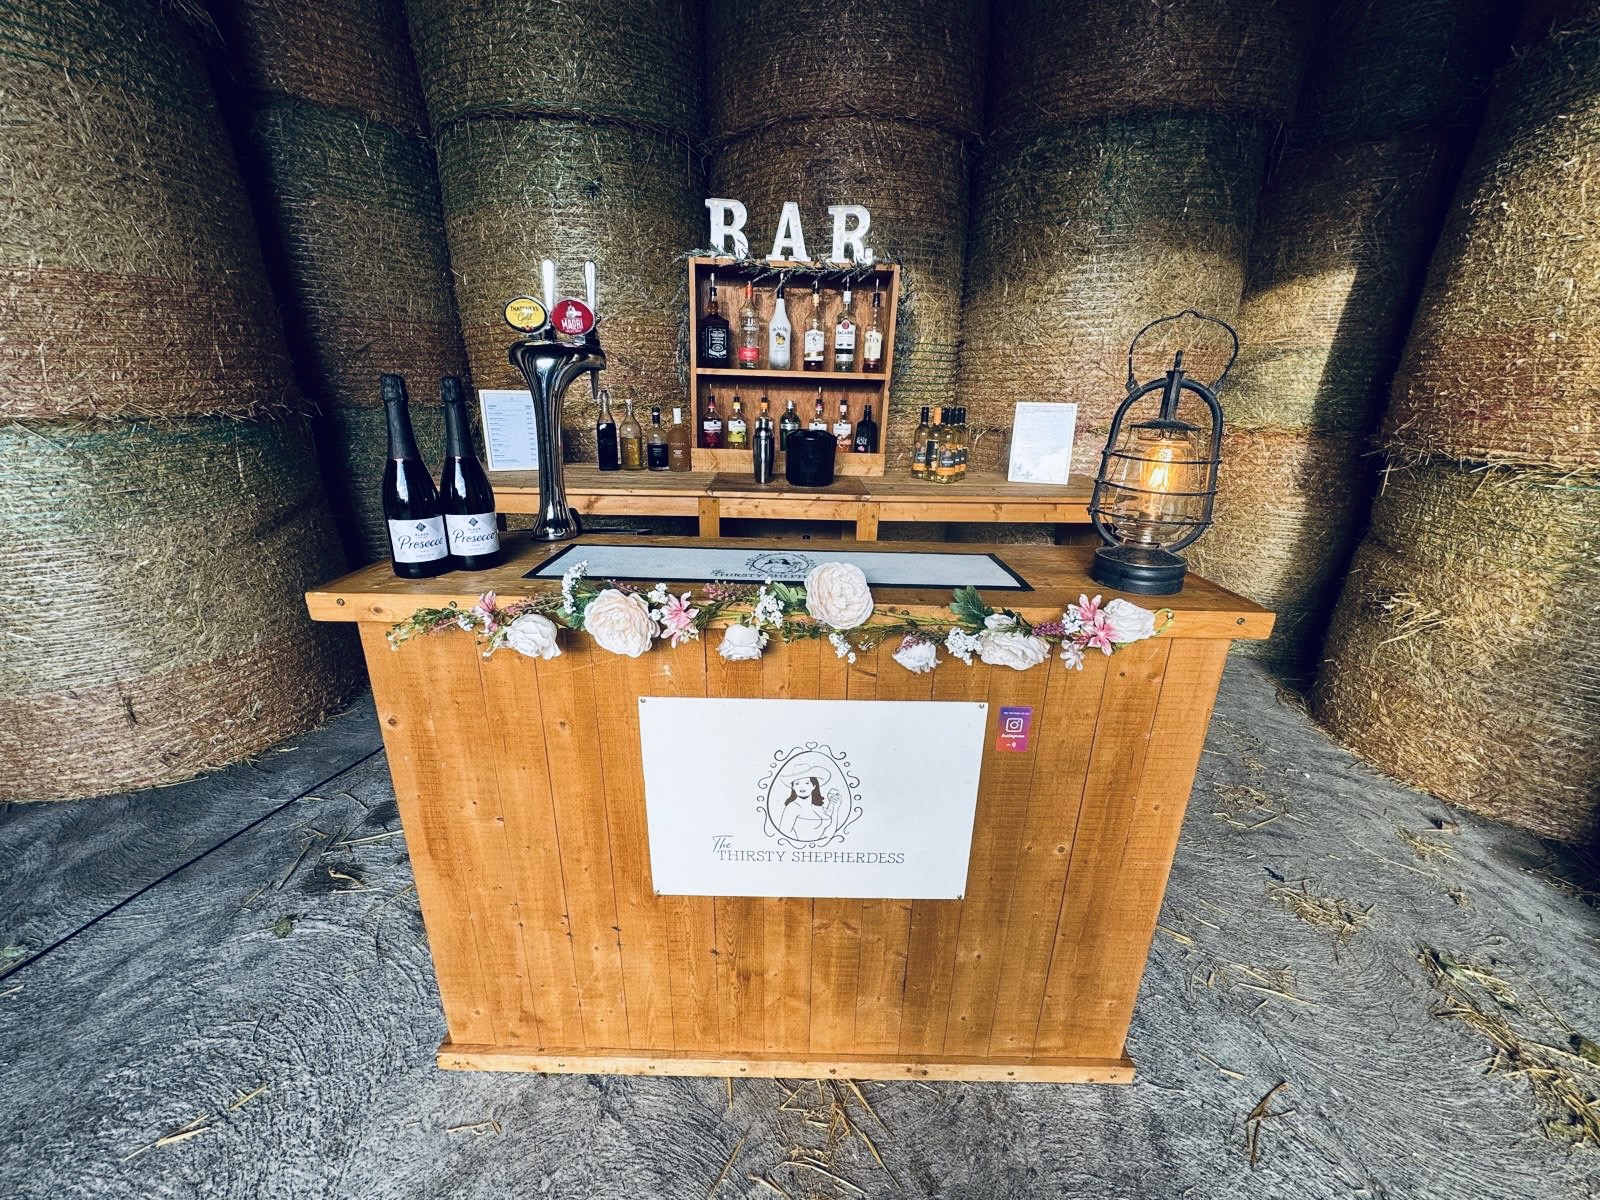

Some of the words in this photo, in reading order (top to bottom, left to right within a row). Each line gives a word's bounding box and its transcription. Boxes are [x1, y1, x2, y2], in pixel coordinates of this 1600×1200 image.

[704, 197, 874, 266] BAR
[398, 535, 443, 550] Prosecco
[453, 529, 496, 543] Prosecco
[712, 835, 733, 853] The
[718, 850, 787, 862] THIRSTY
[791, 851, 906, 864] SHEPHERDESS
